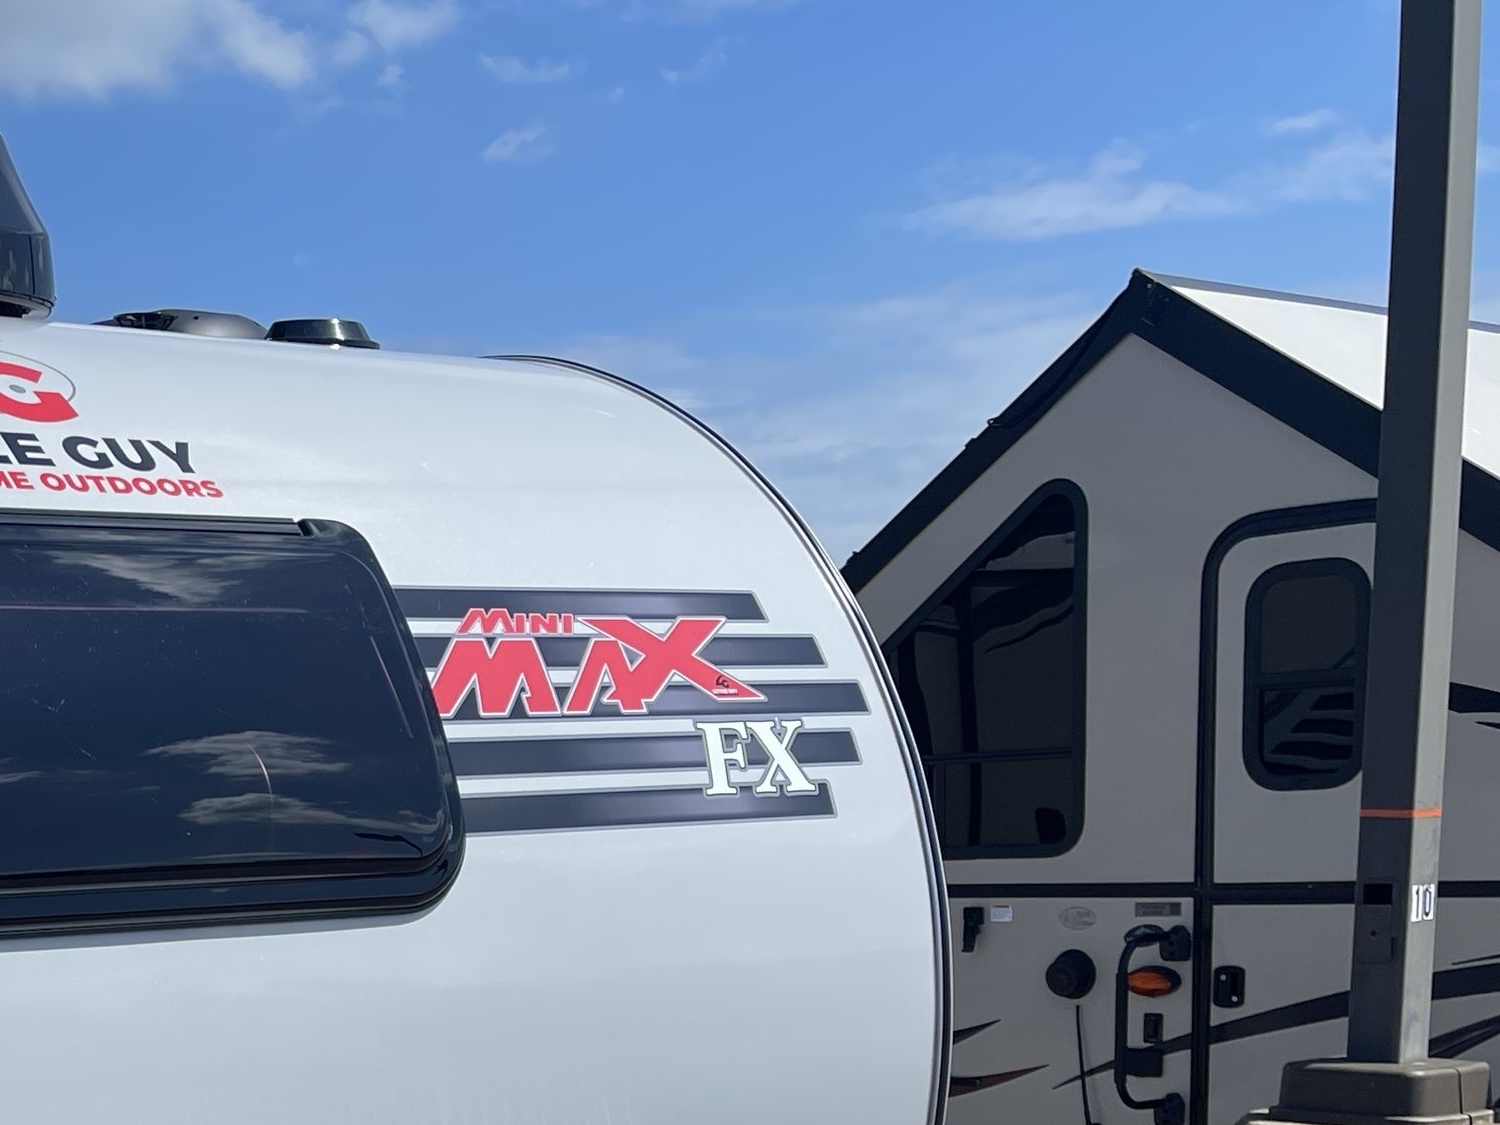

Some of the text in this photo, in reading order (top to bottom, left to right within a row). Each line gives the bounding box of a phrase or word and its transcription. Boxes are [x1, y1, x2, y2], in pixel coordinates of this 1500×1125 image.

[62, 436, 196, 474] GUY
[39, 472, 224, 499] OUTDOORS
[455, 608, 574, 635] MINI
[430, 616, 767, 716] MAX
[694, 718, 818, 798] FX
[1414, 886, 1432, 919] 10
